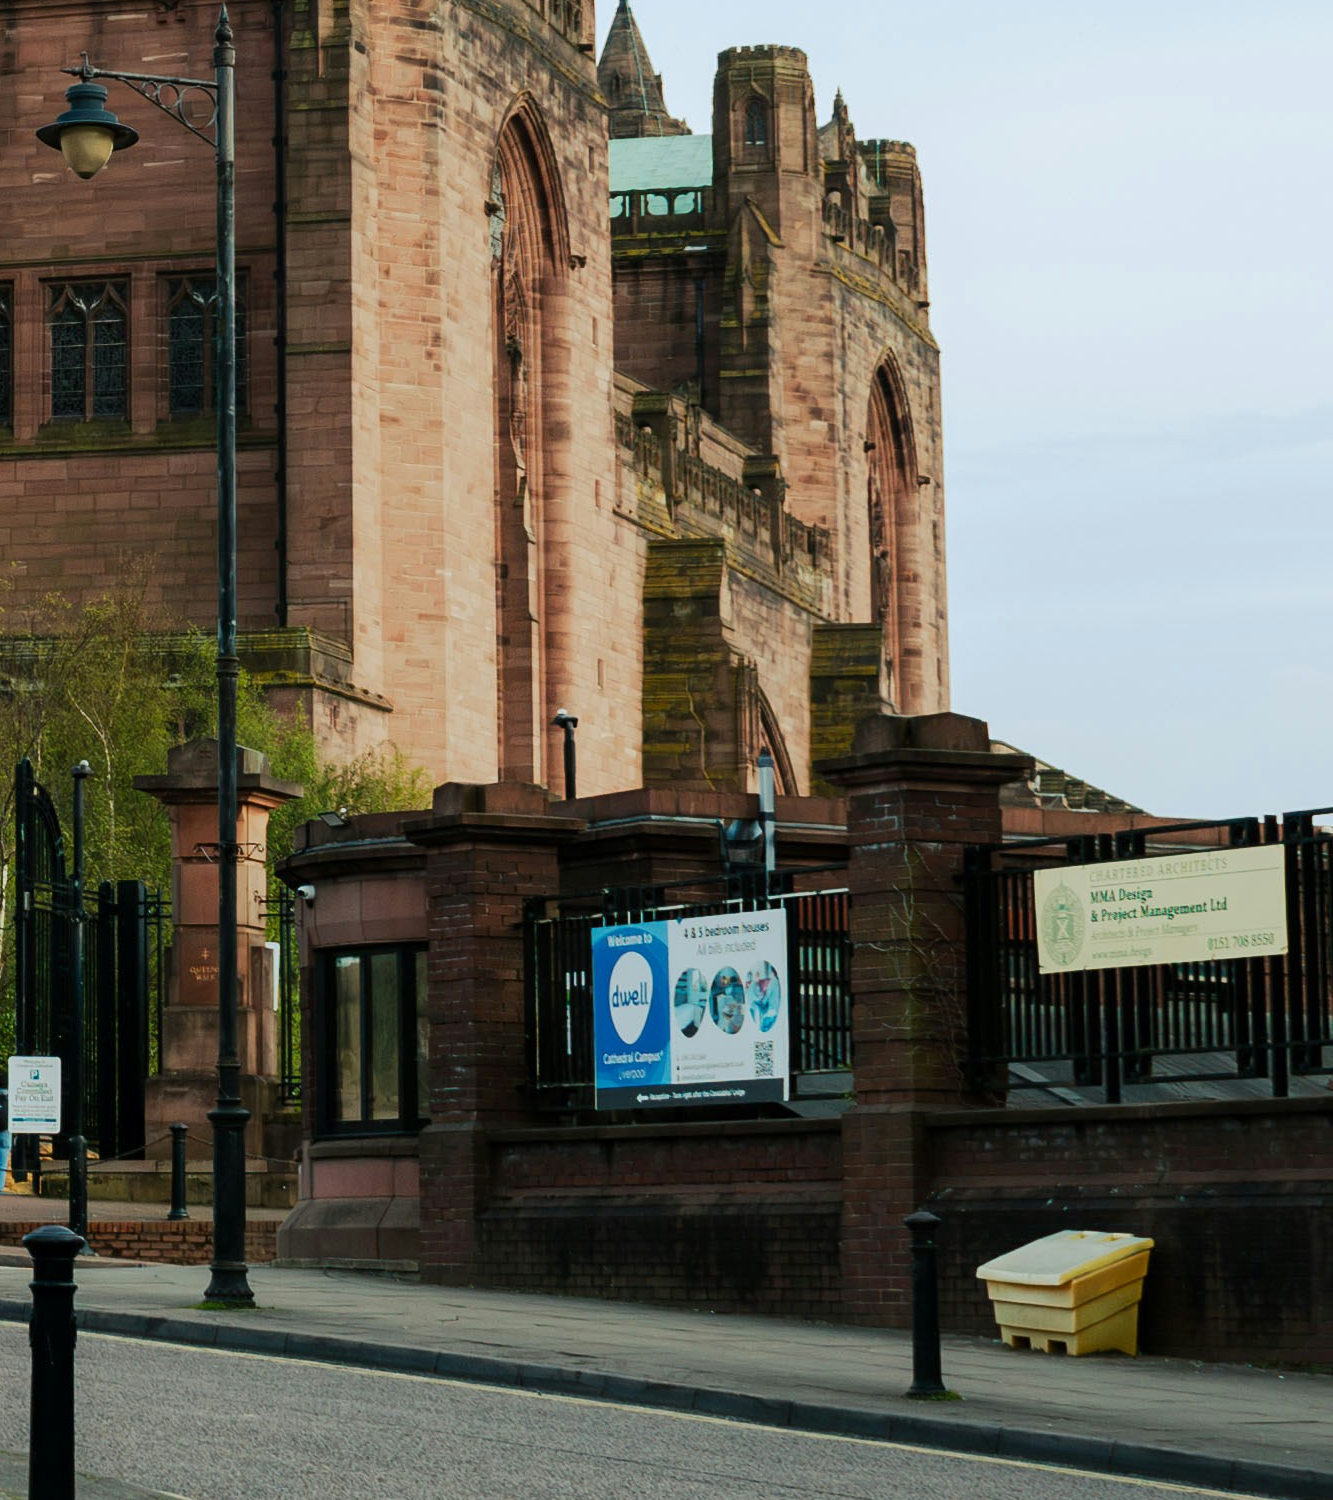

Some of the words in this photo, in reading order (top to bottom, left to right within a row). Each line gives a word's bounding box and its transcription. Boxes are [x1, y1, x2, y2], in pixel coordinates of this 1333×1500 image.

[1089, 865, 1153, 882] CHARTERED
[1157, 857, 1228, 876] ARCHITECTS
[1090, 890, 1116, 904] MMA
[1118, 886, 1153, 904] Design
[1090, 910, 1098, 923] &
[1101, 906, 1138, 924] Project
[1140, 901, 1208, 920] Management
[1210, 896, 1228, 912] Ltd
[684, 928, 689, 939] 4
[691, 927, 697, 938] &
[698, 926, 704, 938] 5
[705, 924, 740, 937] bedroom
[742, 922, 770, 934] houses
[607, 934, 643, 947] Welcome
[643, 932, 653, 944] to
[697, 943, 707, 956] All
[724, 940, 757, 954] included
[1207, 937, 1229, 950] 0151
[1233, 936, 1249, 948] 708
[1251, 933, 1275, 946] 8550
[612, 982, 649, 1008] dwell
[603, 1052, 633, 1064] Cathedral
